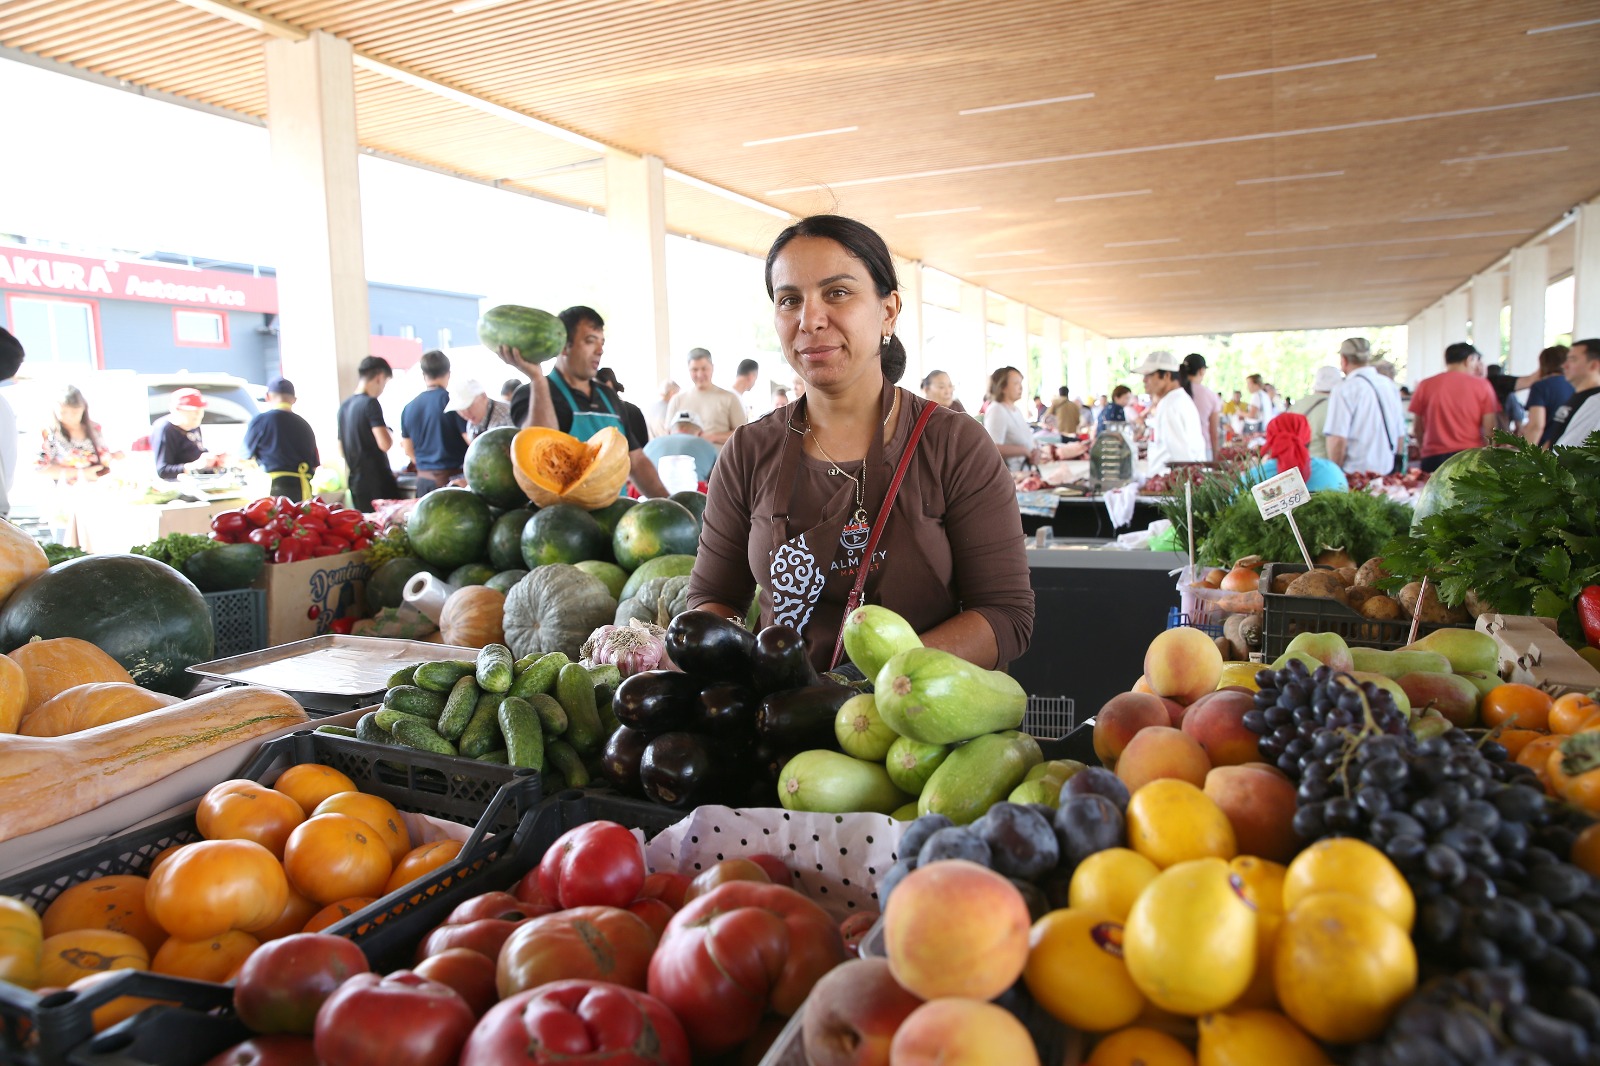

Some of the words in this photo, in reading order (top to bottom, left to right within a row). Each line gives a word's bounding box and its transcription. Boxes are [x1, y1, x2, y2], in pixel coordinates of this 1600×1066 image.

[125, 275, 246, 306] Autoservice
[1280, 493, 1301, 510] 350
[830, 550, 887, 570] ALMTY
[841, 563, 879, 576] MAET
